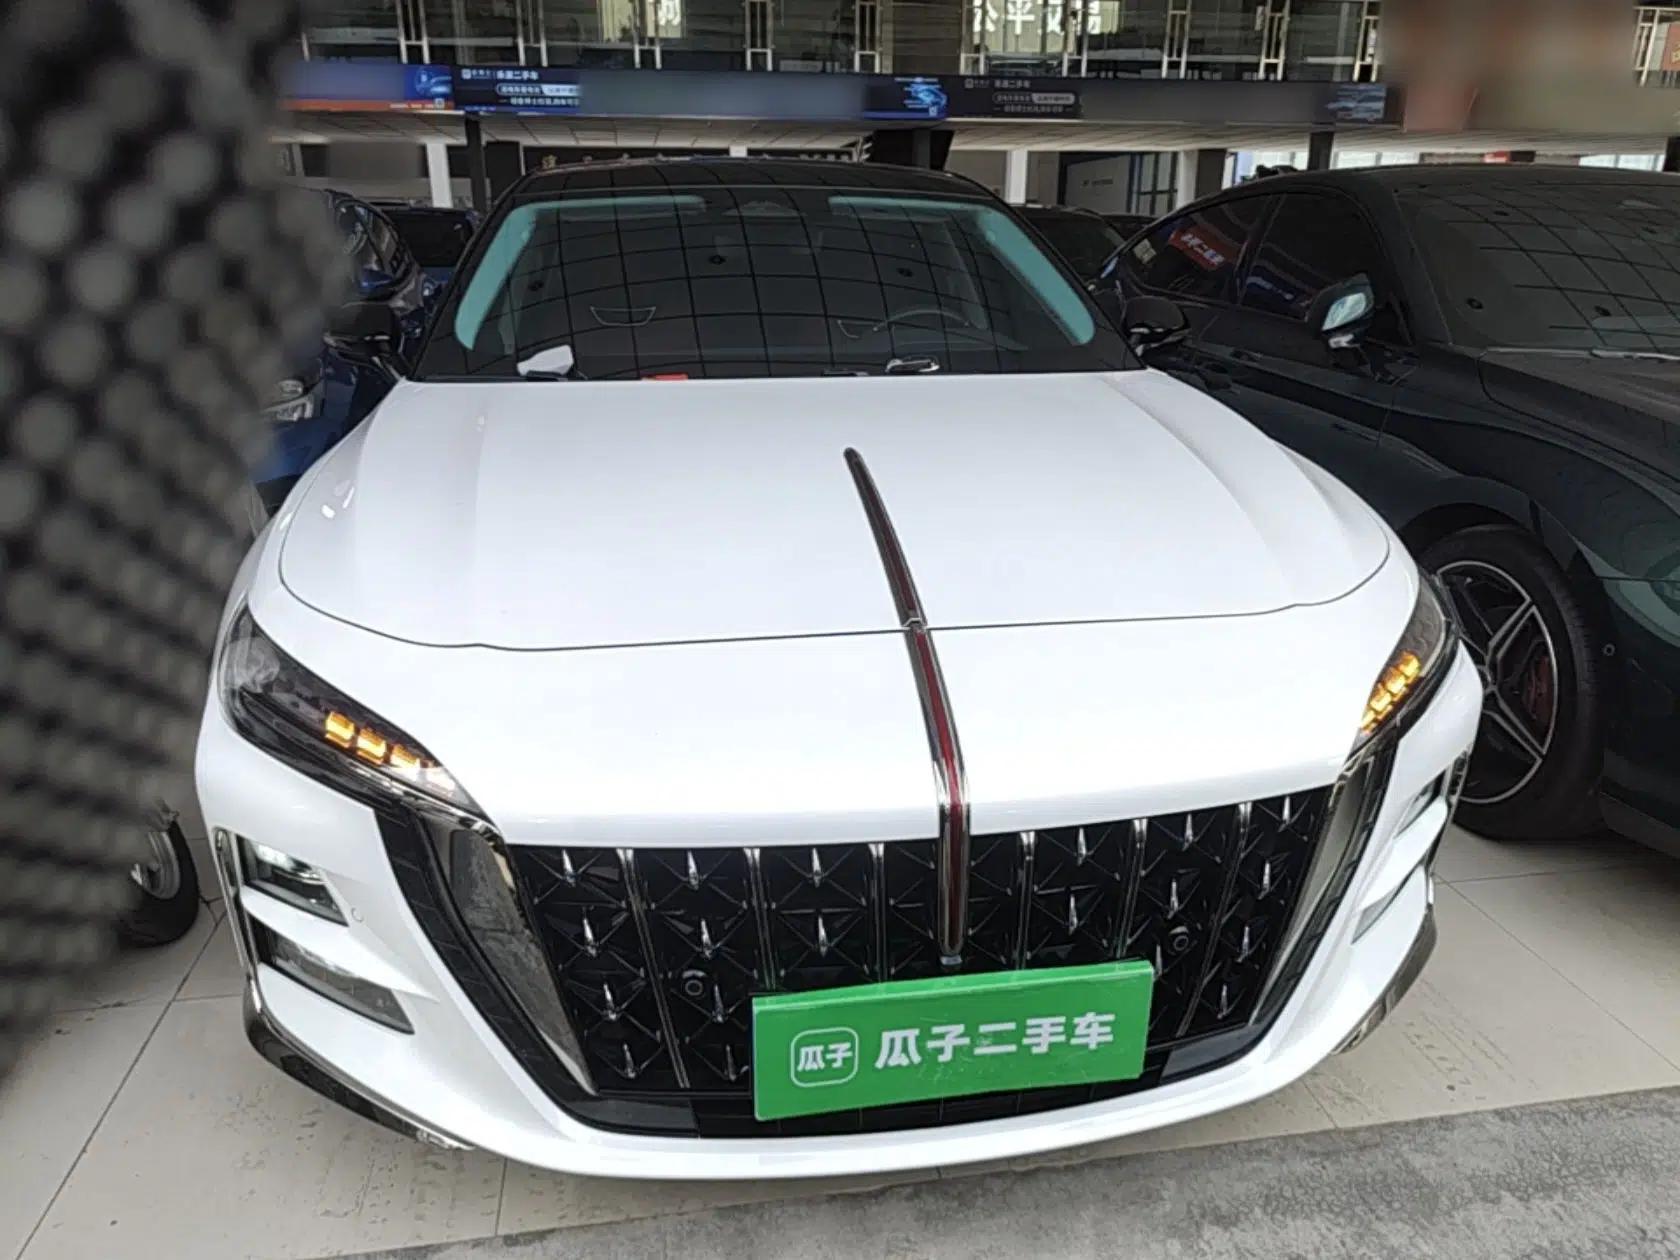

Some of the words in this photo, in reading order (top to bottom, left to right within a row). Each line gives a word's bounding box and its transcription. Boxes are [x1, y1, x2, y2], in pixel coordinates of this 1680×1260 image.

[797, 1042, 853, 1072] 瓜子
[875, 1012, 1115, 1070] 瓜子二手车
